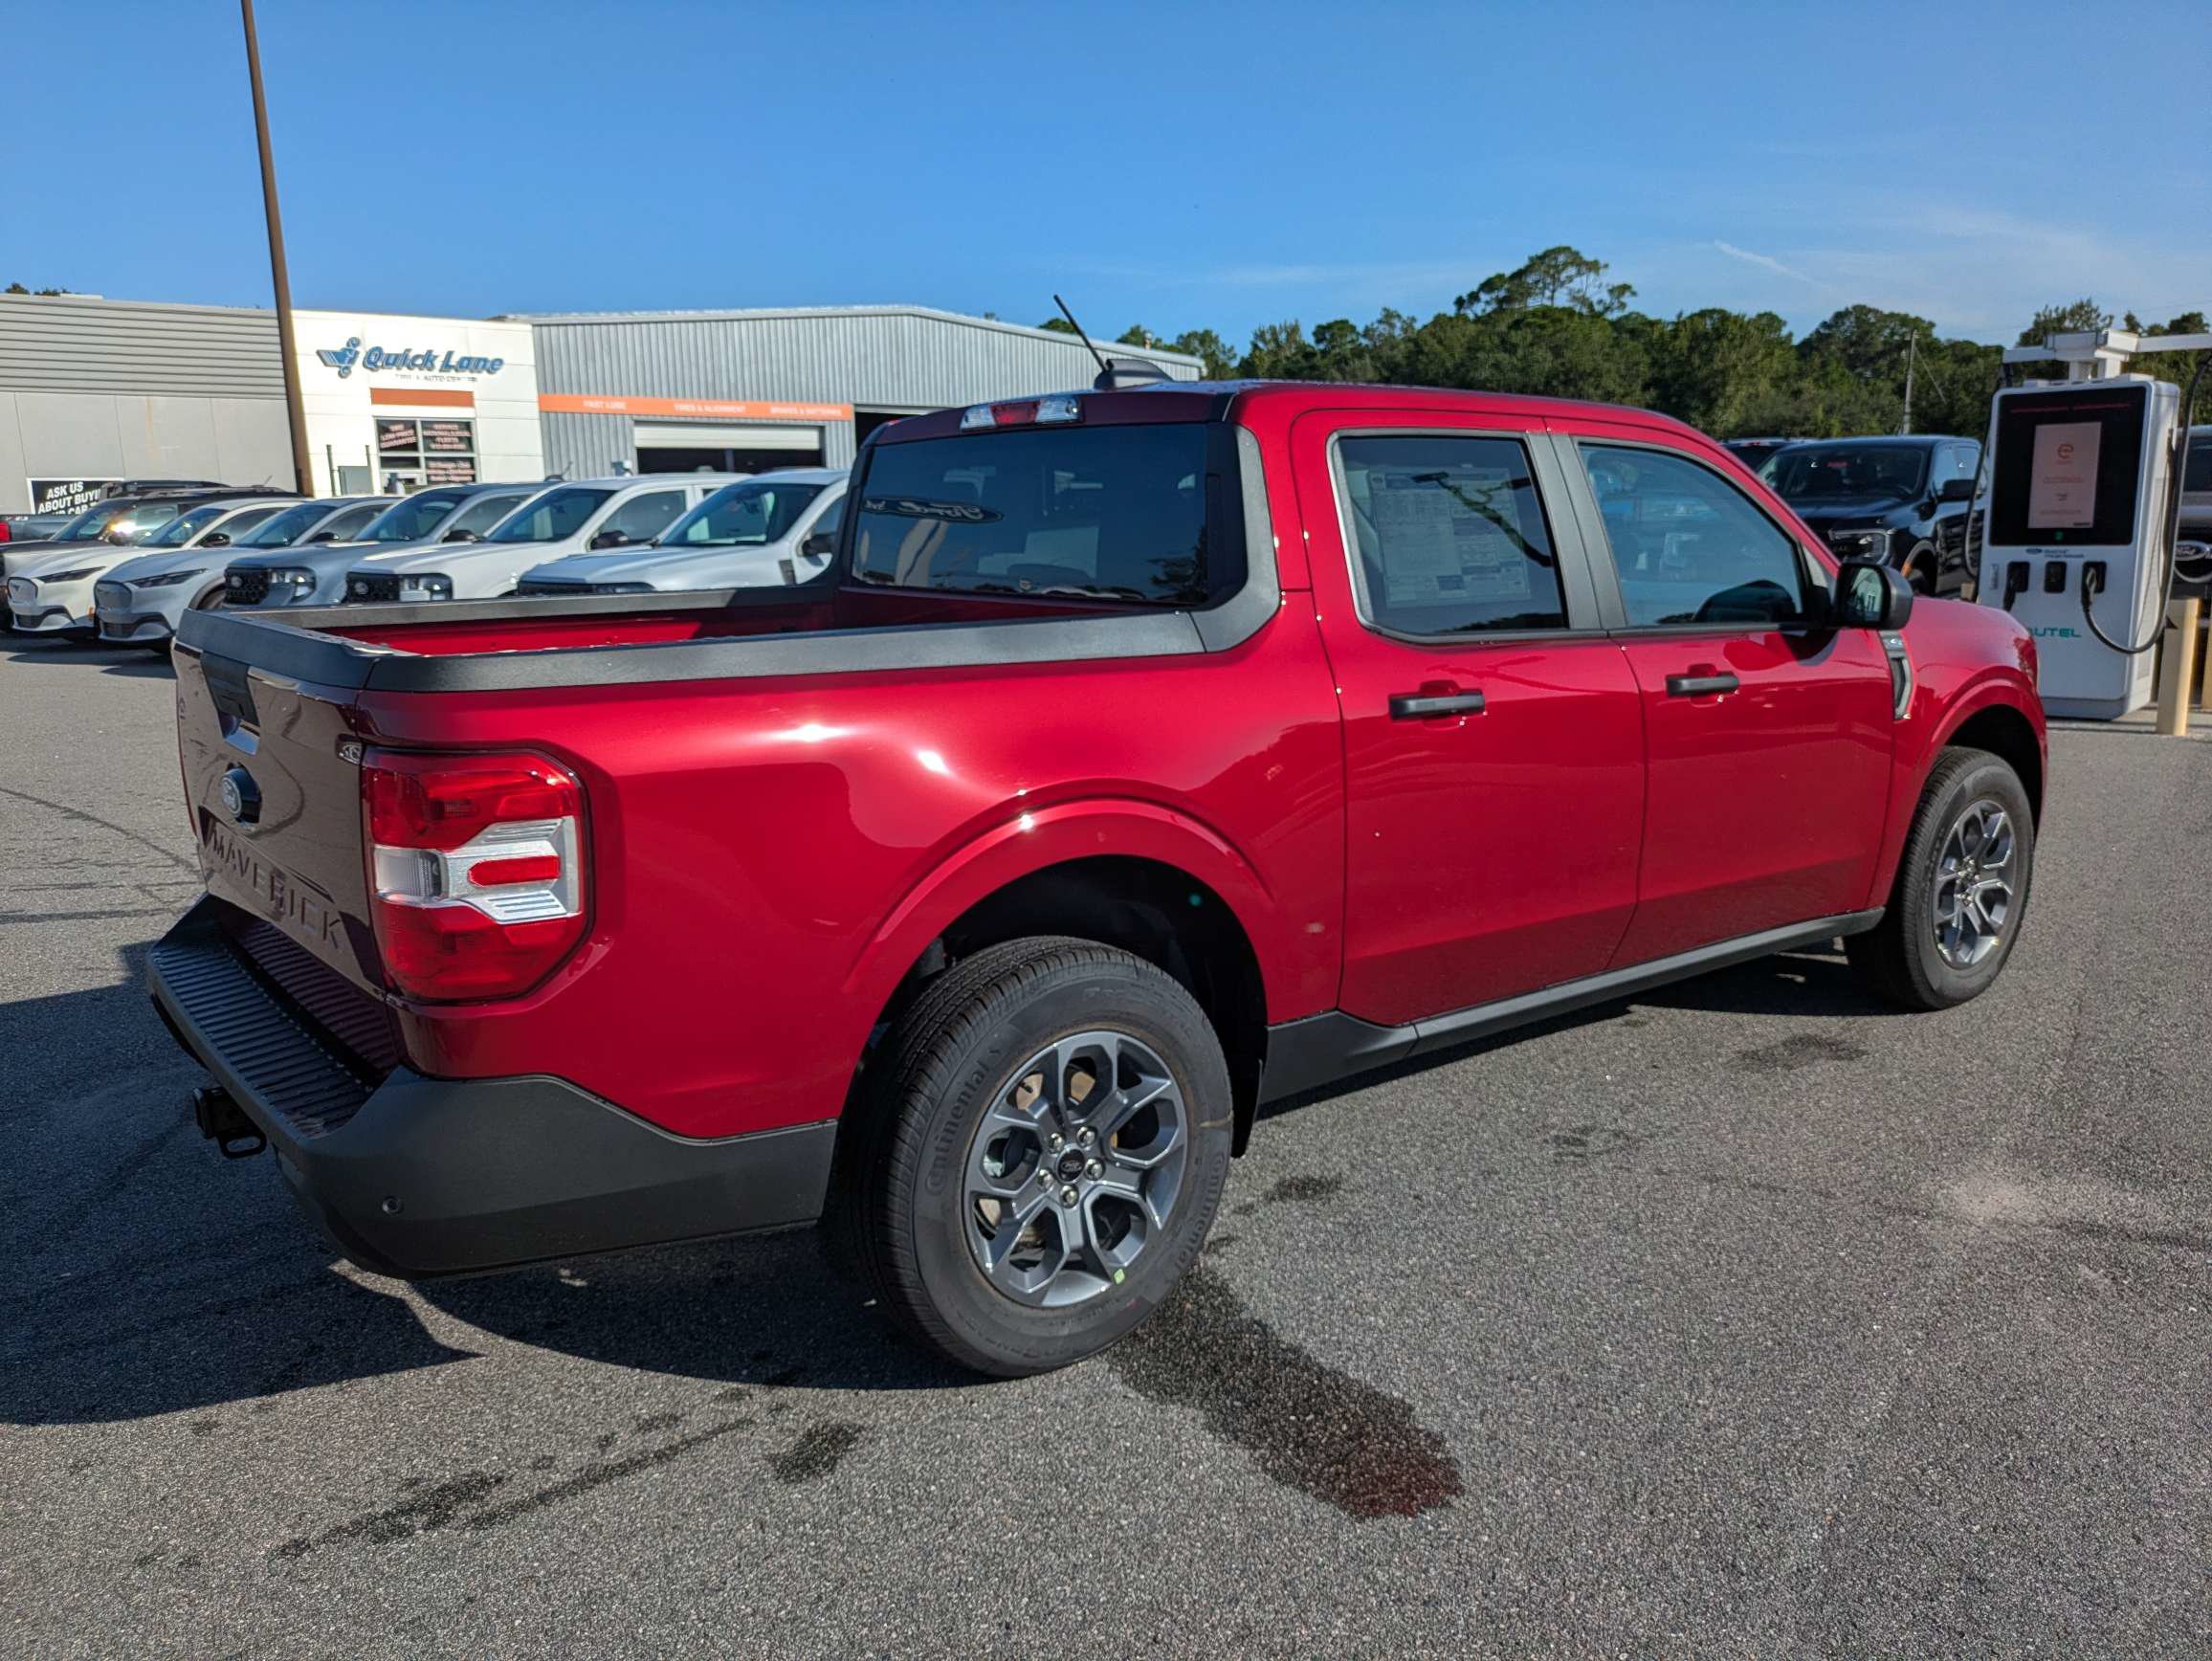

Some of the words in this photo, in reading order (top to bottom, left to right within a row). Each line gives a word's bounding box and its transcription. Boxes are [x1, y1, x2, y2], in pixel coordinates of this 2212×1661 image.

[363, 345, 438, 371] Quick
[439, 350, 504, 374] Lane
[38, 496, 73, 514] ABOUT
[46, 484, 68, 500] ASK
[69, 481, 84, 494] US
[203, 821, 343, 950] MAVERICK
[924, 1057, 991, 1194] Continental
